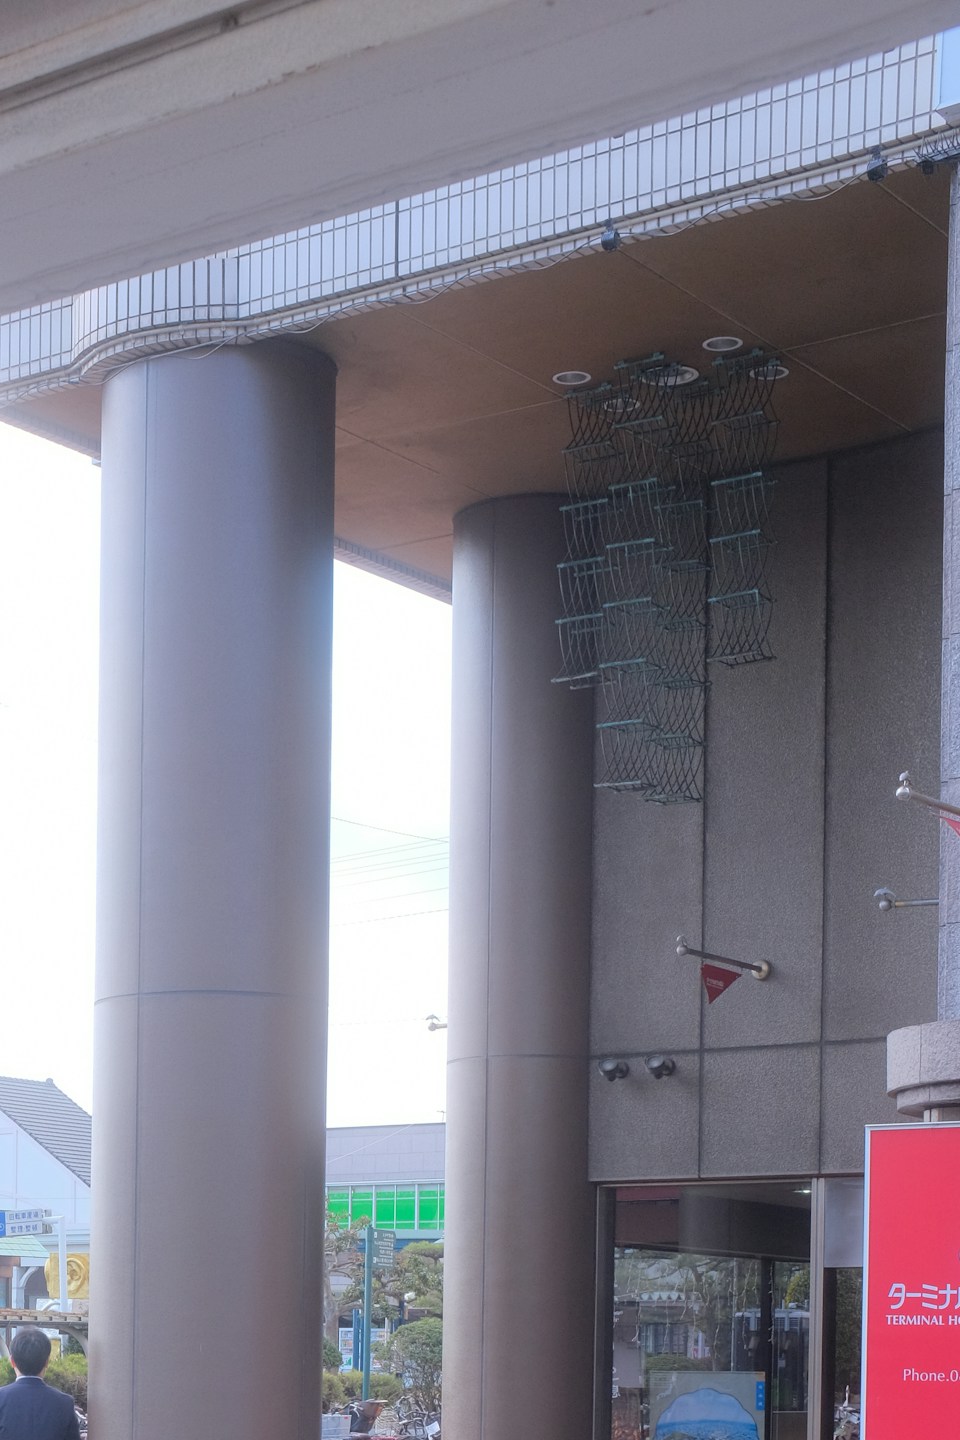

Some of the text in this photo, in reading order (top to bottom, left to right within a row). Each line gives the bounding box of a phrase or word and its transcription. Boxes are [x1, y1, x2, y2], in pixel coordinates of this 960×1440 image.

[885, 1314, 960, 1326] TERMINAL H
[903, 1367, 960, 1383] Phone.0
